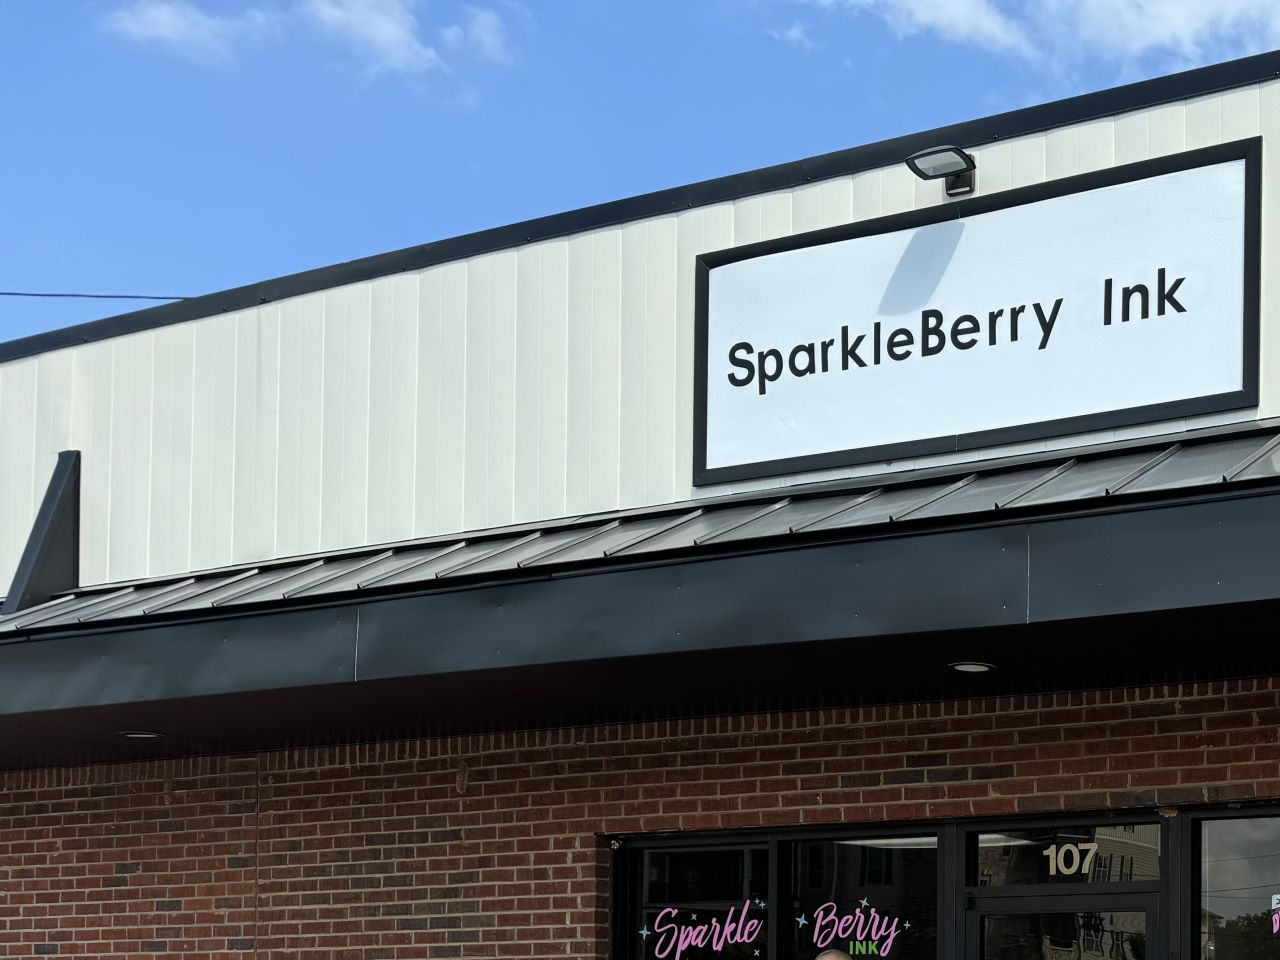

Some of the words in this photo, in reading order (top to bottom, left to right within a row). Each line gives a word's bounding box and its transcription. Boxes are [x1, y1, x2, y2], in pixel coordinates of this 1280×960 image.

[727, 298, 1064, 395] SparkleBerry
[1103, 268, 1188, 327] Ink
[1042, 843, 1098, 876] 107
[812, 900, 901, 957] Berry
[848, 940, 879, 956] INK
